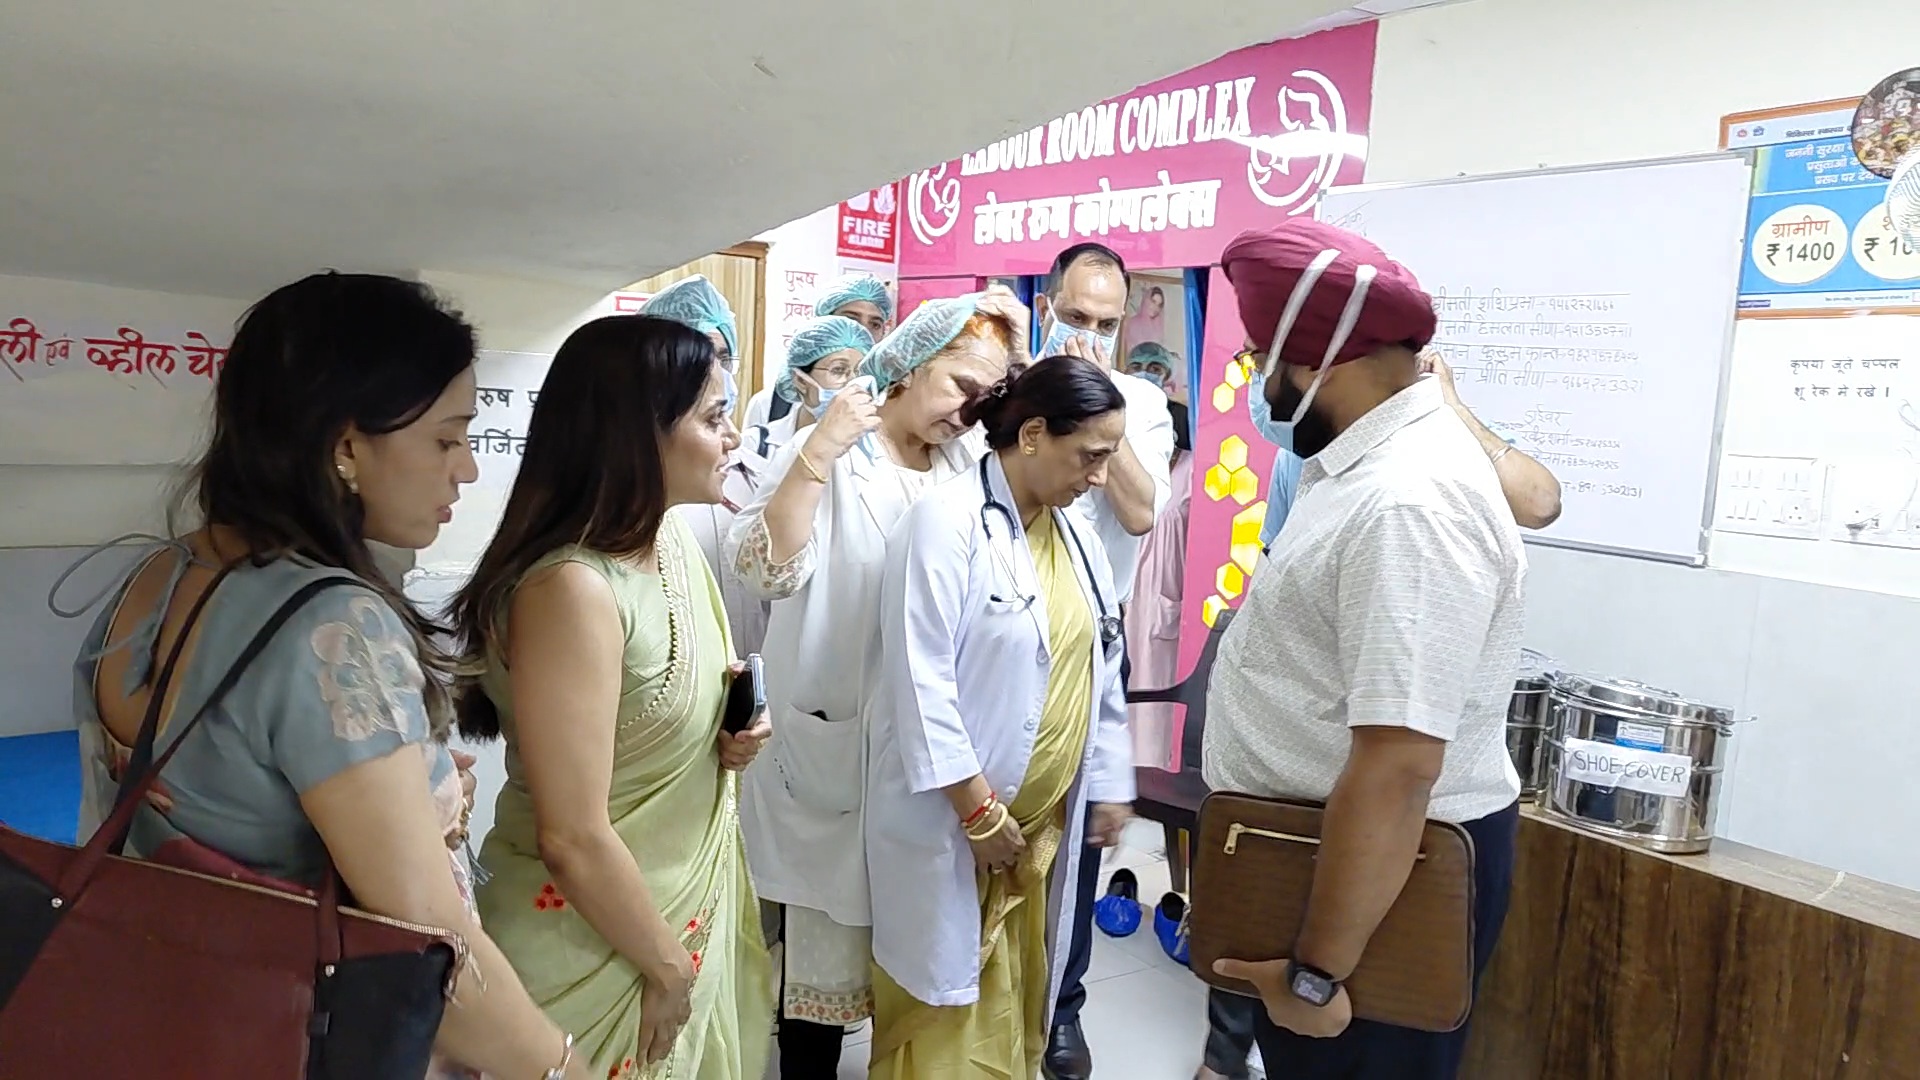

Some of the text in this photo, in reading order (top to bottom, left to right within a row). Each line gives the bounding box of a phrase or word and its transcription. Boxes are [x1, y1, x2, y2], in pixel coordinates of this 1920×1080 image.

[1045, 102, 1119, 165] ROOM
[1119, 76, 1256, 154] COMPLEX
[842, 215, 892, 239] FIRE
[973, 191, 1027, 245] लेबर
[1771, 215, 1831, 239] ग्रामीण
[1790, 356, 1901, 375] कृपया जूते चप्पल
[1811, 384, 1831, 397] रेक
[1574, 750, 1686, 783] SHOE COVER
